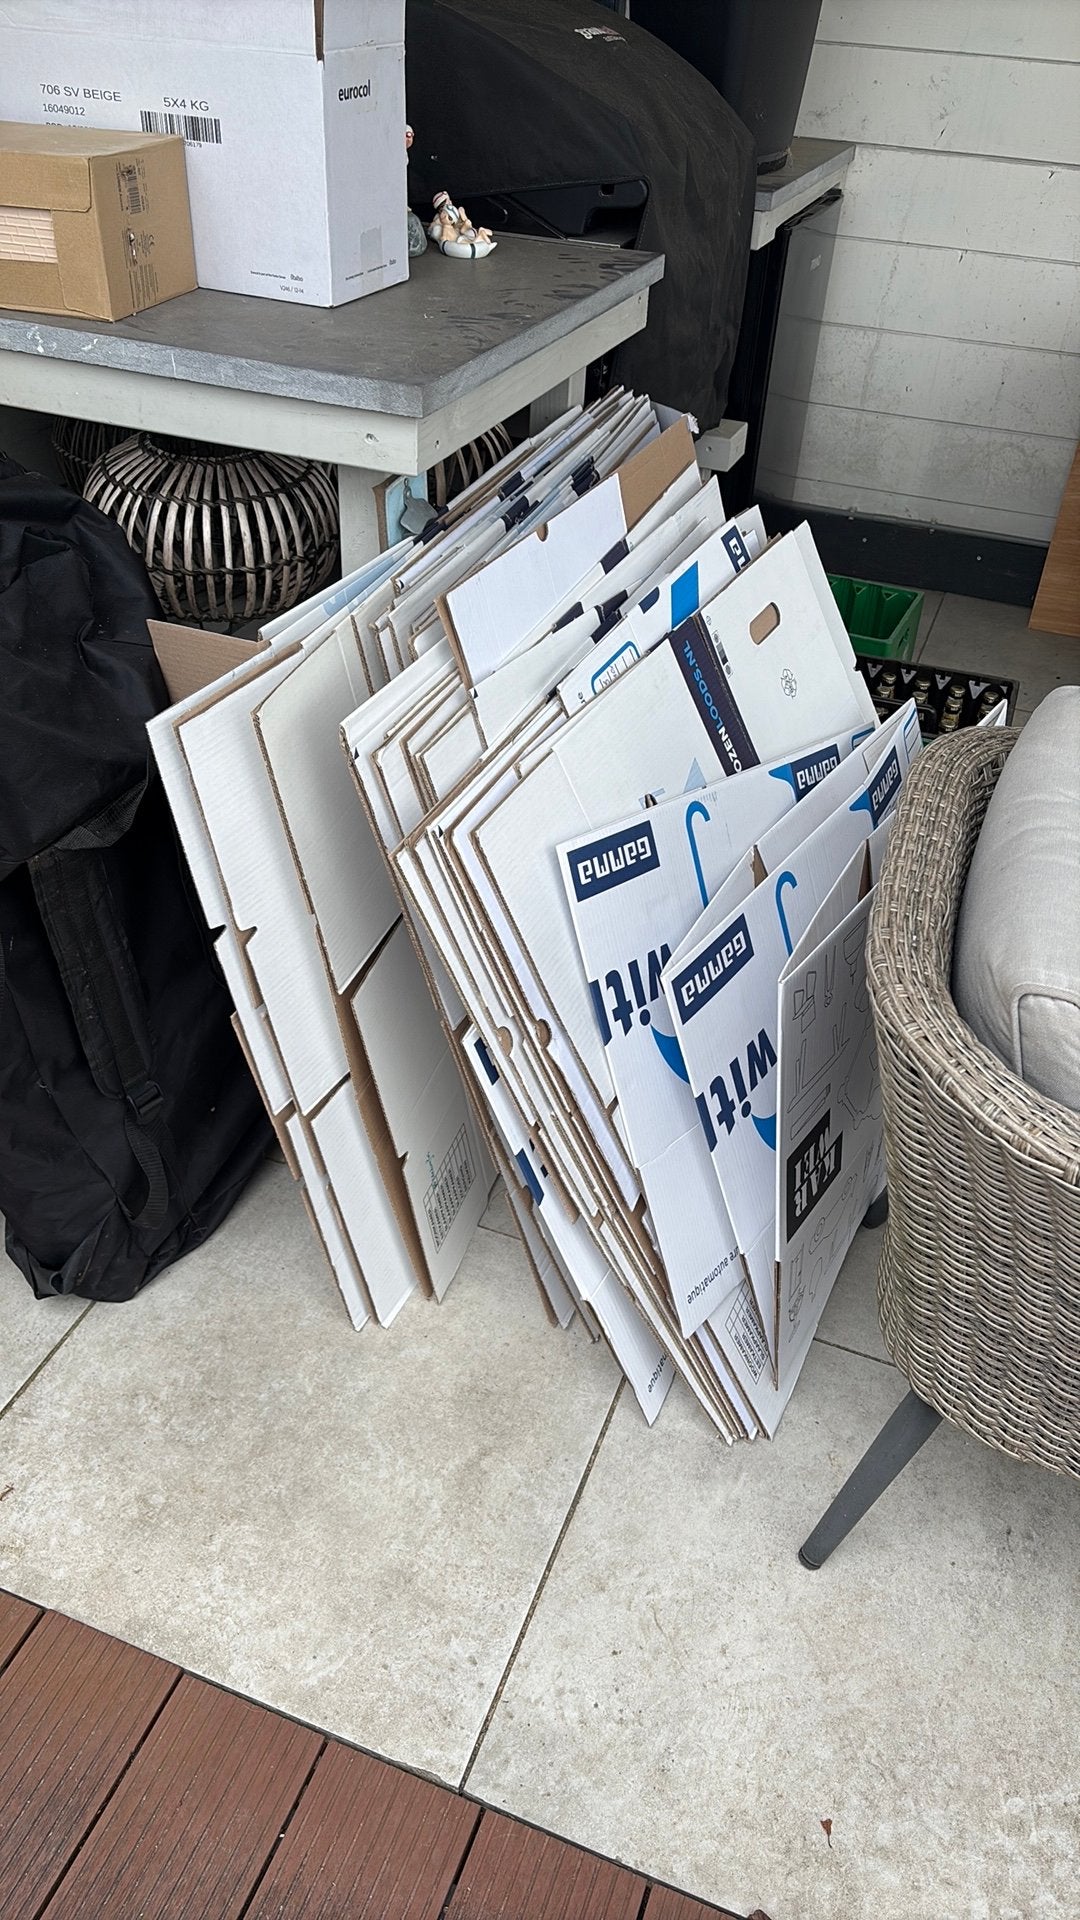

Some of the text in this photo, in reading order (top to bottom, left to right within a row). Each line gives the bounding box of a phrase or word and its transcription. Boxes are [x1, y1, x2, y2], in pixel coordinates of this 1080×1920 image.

[40, 84, 122, 102] 706 SV BEIGE
[338, 79, 371, 101] eurocol
[43, 103, 86, 116] 16049012
[163, 96, 210, 112] 5X4 KG
[682, 640, 742, 773] OZENLOODS.NL
[687, 1257, 729, 1304] automatique
